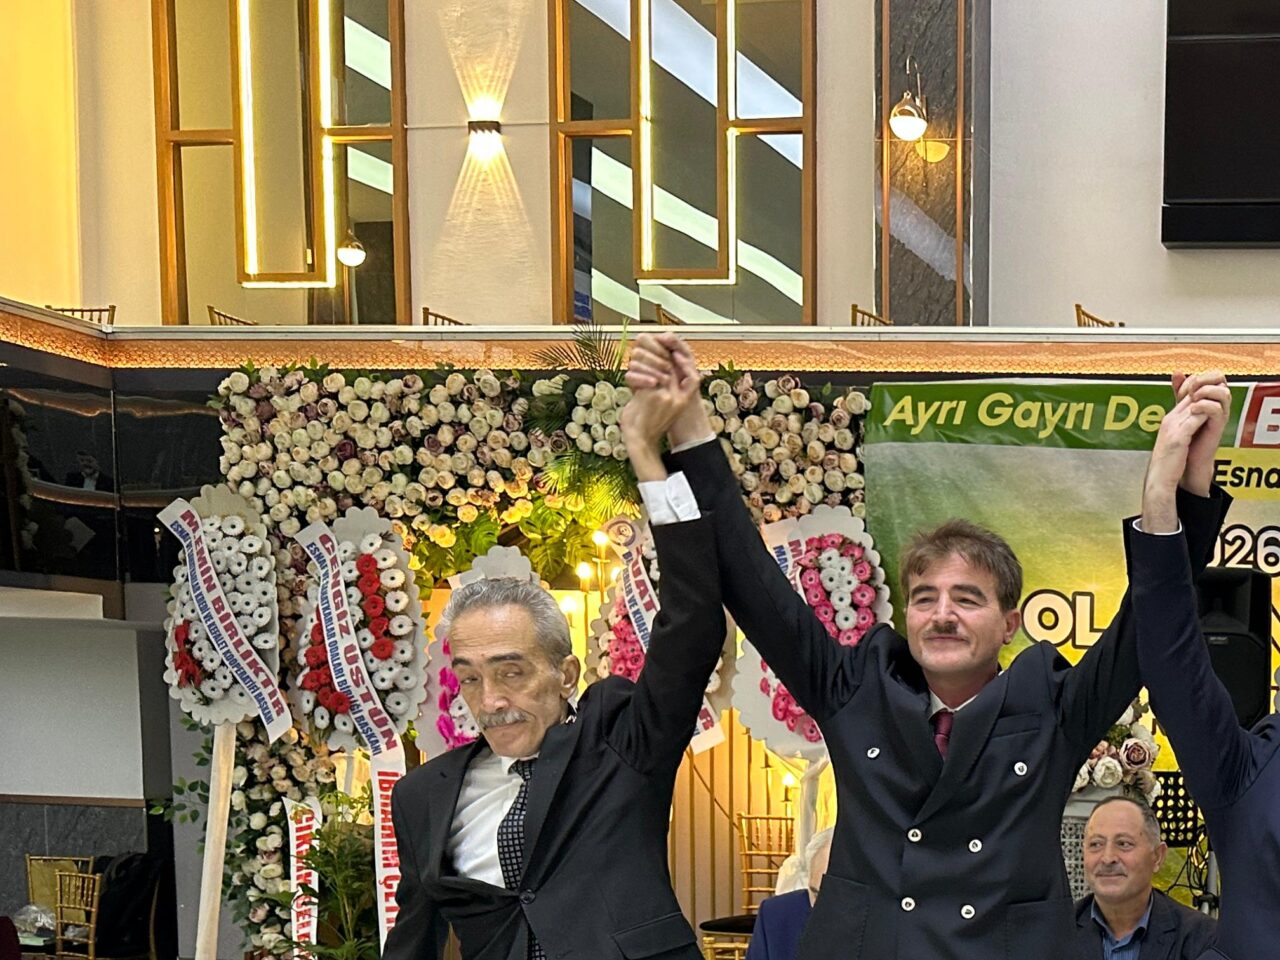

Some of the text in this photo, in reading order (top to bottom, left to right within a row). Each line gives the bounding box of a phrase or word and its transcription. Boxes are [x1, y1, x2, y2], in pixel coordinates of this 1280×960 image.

[883, 395, 967, 435] Ayrı
[977, 392, 1095, 440] Gayrı
[1103, 395, 1167, 433] De
